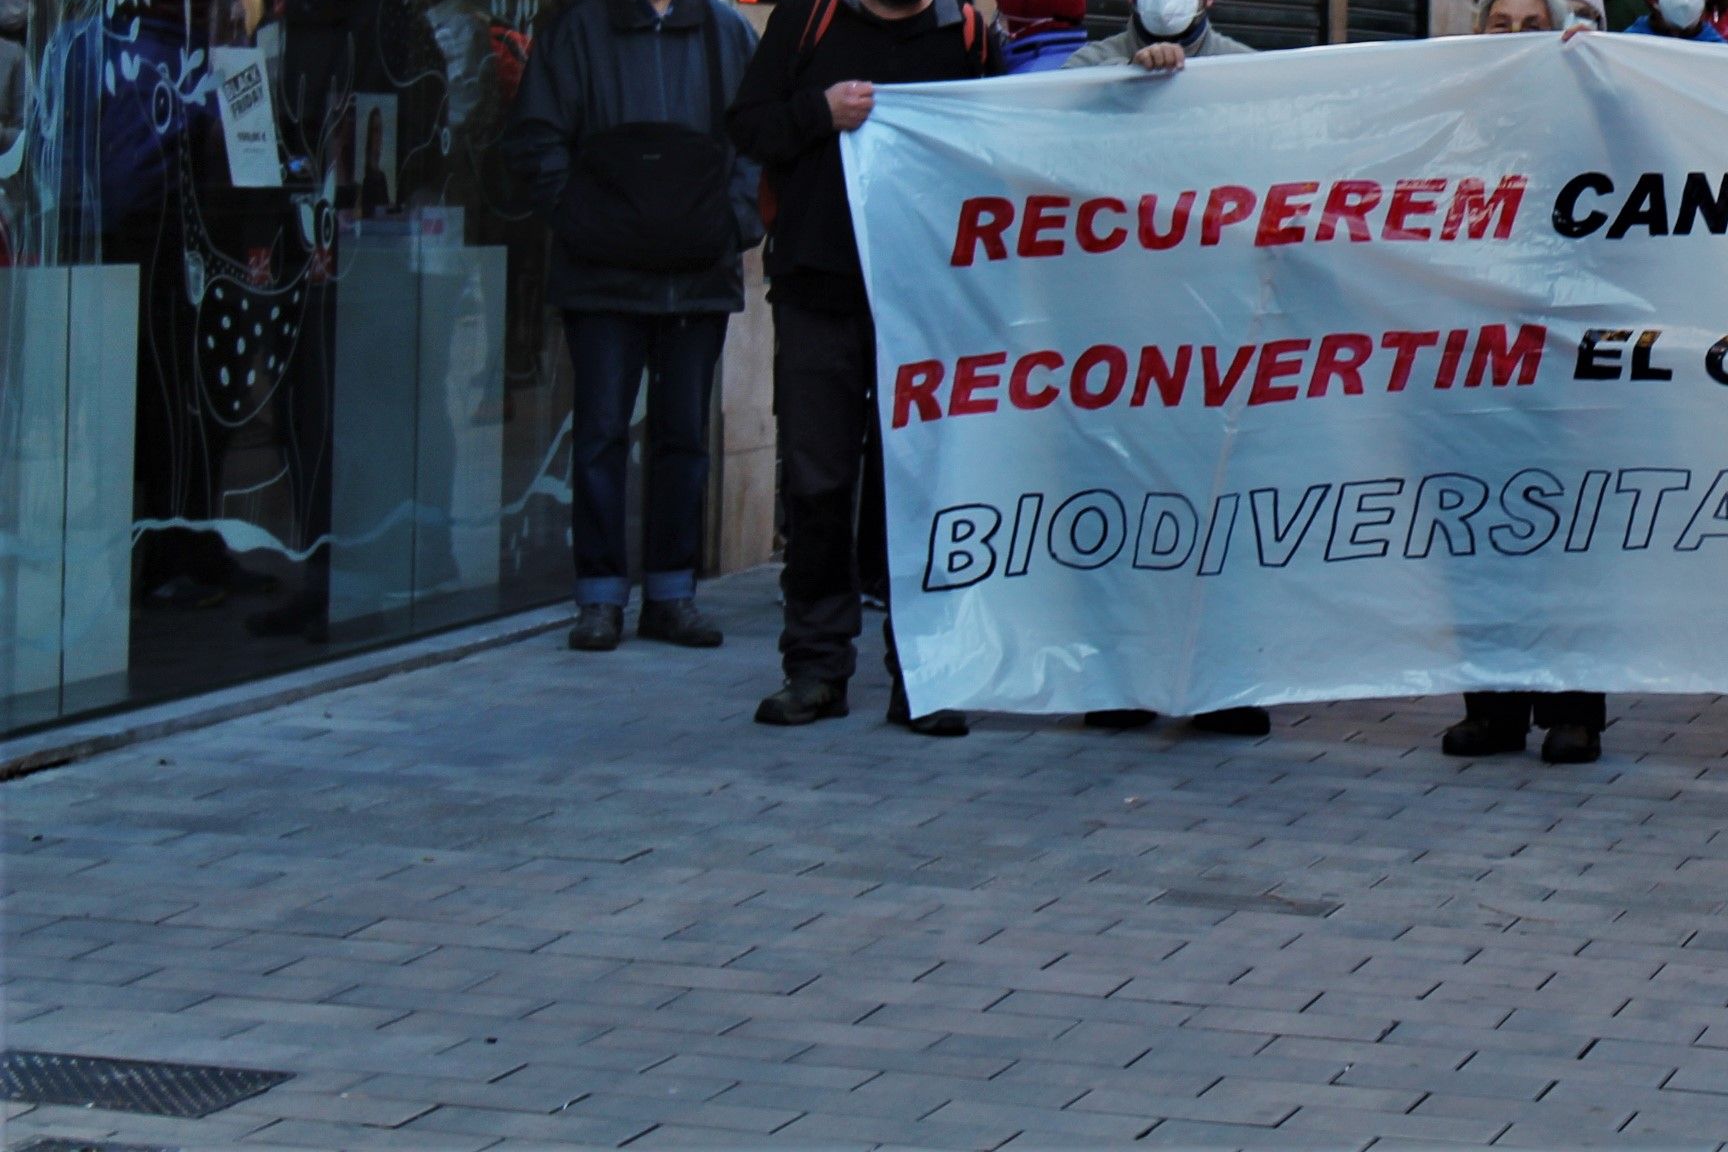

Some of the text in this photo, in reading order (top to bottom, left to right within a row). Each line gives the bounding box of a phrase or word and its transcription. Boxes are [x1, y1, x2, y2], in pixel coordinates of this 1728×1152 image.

[223, 62, 262, 102] BLACK
[950, 175, 1528, 267] RECUPEREM
[891, 323, 1547, 429] RECONVERTIM
[1573, 328, 1675, 382] EL
